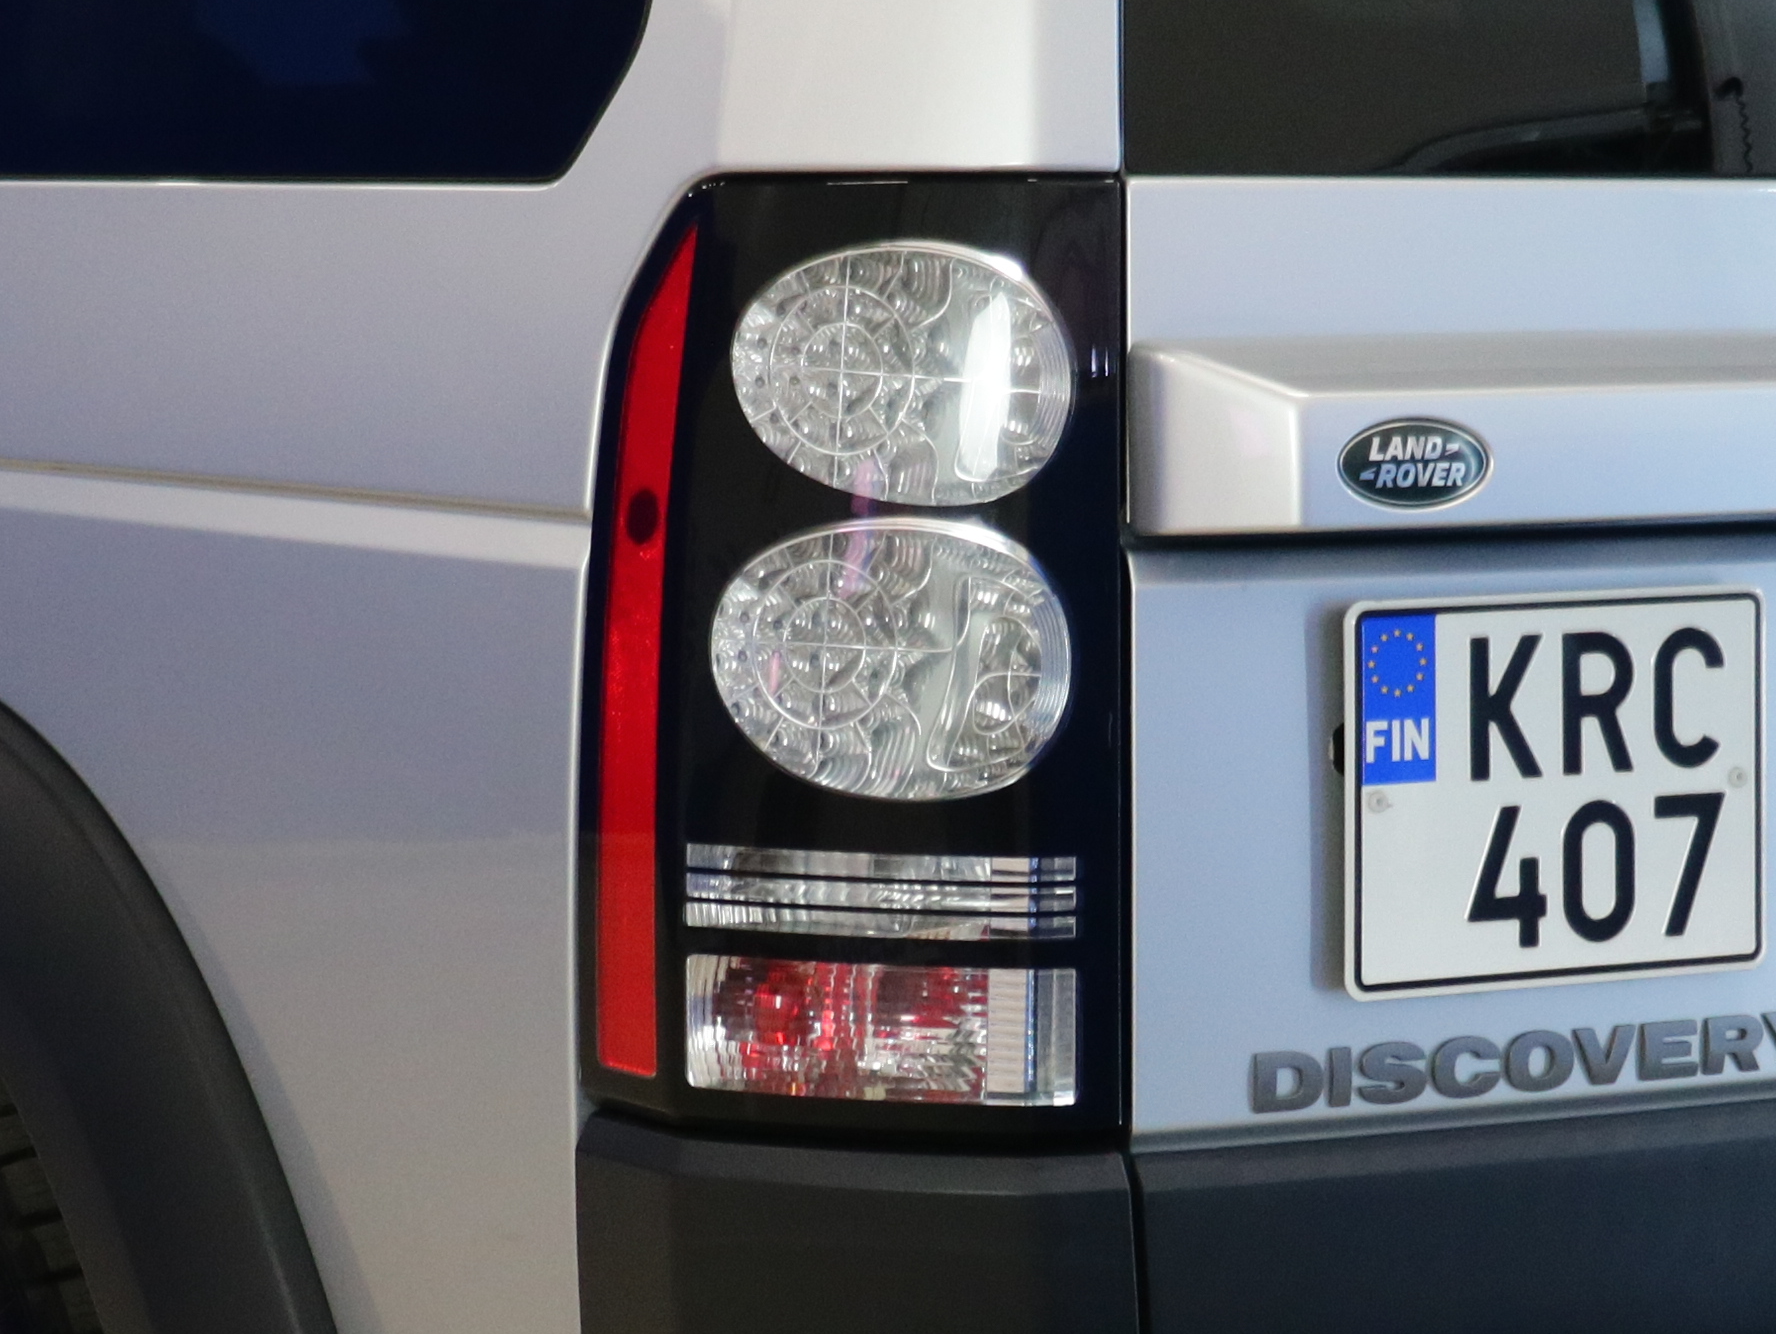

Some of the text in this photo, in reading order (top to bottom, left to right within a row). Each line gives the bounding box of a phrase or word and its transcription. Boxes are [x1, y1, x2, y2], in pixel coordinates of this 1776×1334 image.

[1368, 435, 1443, 462] LAND
[1374, 461, 1466, 489] ROVER
[1468, 626, 1726, 781] KRC
[1365, 716, 1431, 764] FIN
[1465, 791, 1726, 949] 407
